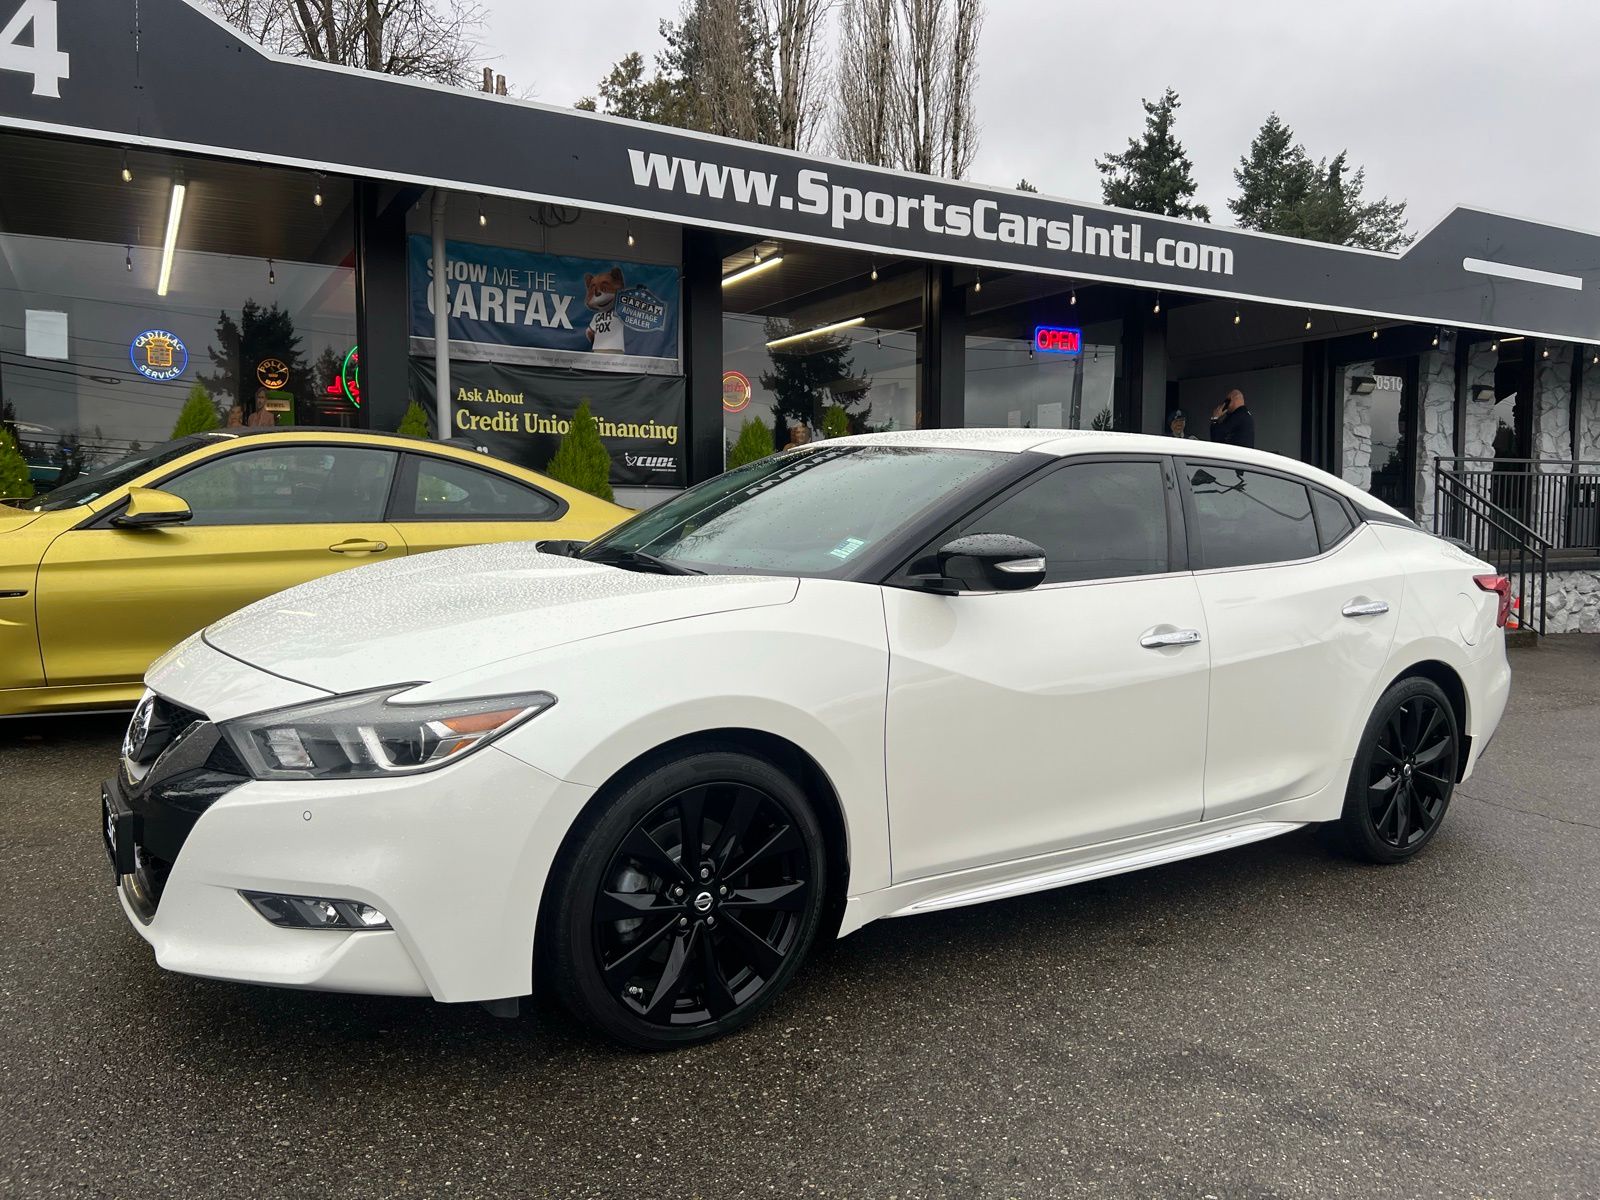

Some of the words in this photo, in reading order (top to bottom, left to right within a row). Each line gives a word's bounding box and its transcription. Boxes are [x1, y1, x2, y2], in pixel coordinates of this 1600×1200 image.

[0, 0, 69, 98] 4
[627, 148, 1234, 275] www.SportsCarsIntl.com
[493, 267, 518, 288] ME
[524, 270, 556, 292] THE
[621, 296, 663, 316] CARFAX
[622, 306, 658, 323] ADVANTAGE
[625, 316, 650, 328] DEALER
[135, 331, 184, 351] CADILLAC
[1038, 330, 1078, 352] OPEN
[140, 365, 180, 379] SERVICE
[457, 387, 483, 402] Ask
[486, 389, 524, 405] About
[456, 409, 519, 433] Credit
